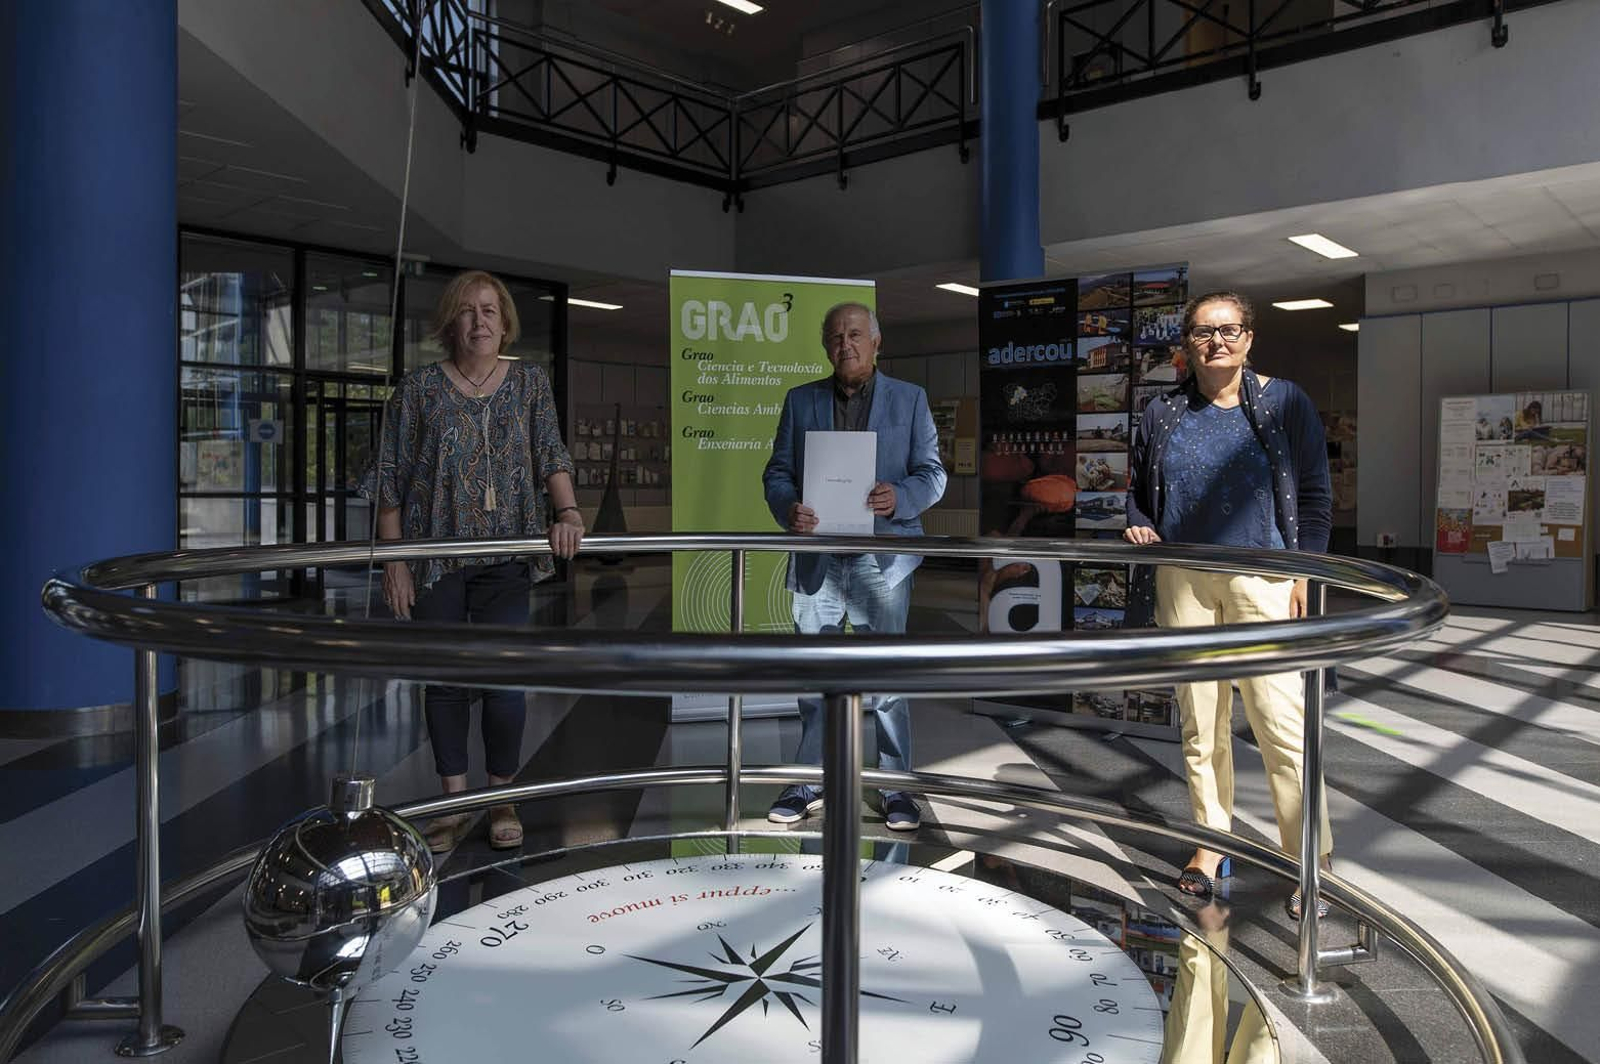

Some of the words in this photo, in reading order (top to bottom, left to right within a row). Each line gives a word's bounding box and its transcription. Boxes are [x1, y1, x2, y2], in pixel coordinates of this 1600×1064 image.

[681, 300, 788, 342] GRAO
[682, 348, 714, 361] Grao
[988, 341, 1072, 364] adercou
[697, 360, 743, 372] Ciencia
[747, 364, 754, 372] e
[758, 361, 823, 374] Tecnoloxía
[697, 373, 718, 385] dos
[721, 374, 782, 386] Alimentos
[682, 391, 714, 404] Grao
[697, 402, 749, 415] Ciencias
[682, 426, 714, 439] Grao
[623, 869, 654, 883] 310
[666, 865, 697, 875] 320
[576, 879, 609, 892] 300
[535, 891, 569, 905] 290
[669, 893, 689, 907] si
[497, 904, 530, 920] 280
[588, 898, 665, 923] muove
[480, 919, 530, 949] 270
[432, 939, 462, 960] 260
[410, 963, 438, 983] 250
[1089, 973, 1118, 987] 70
[391, 989, 420, 1011] 240
[1093, 999, 1120, 1015] 80
[385, 1017, 412, 1039] 230
[1048, 1015, 1090, 1048] 90
